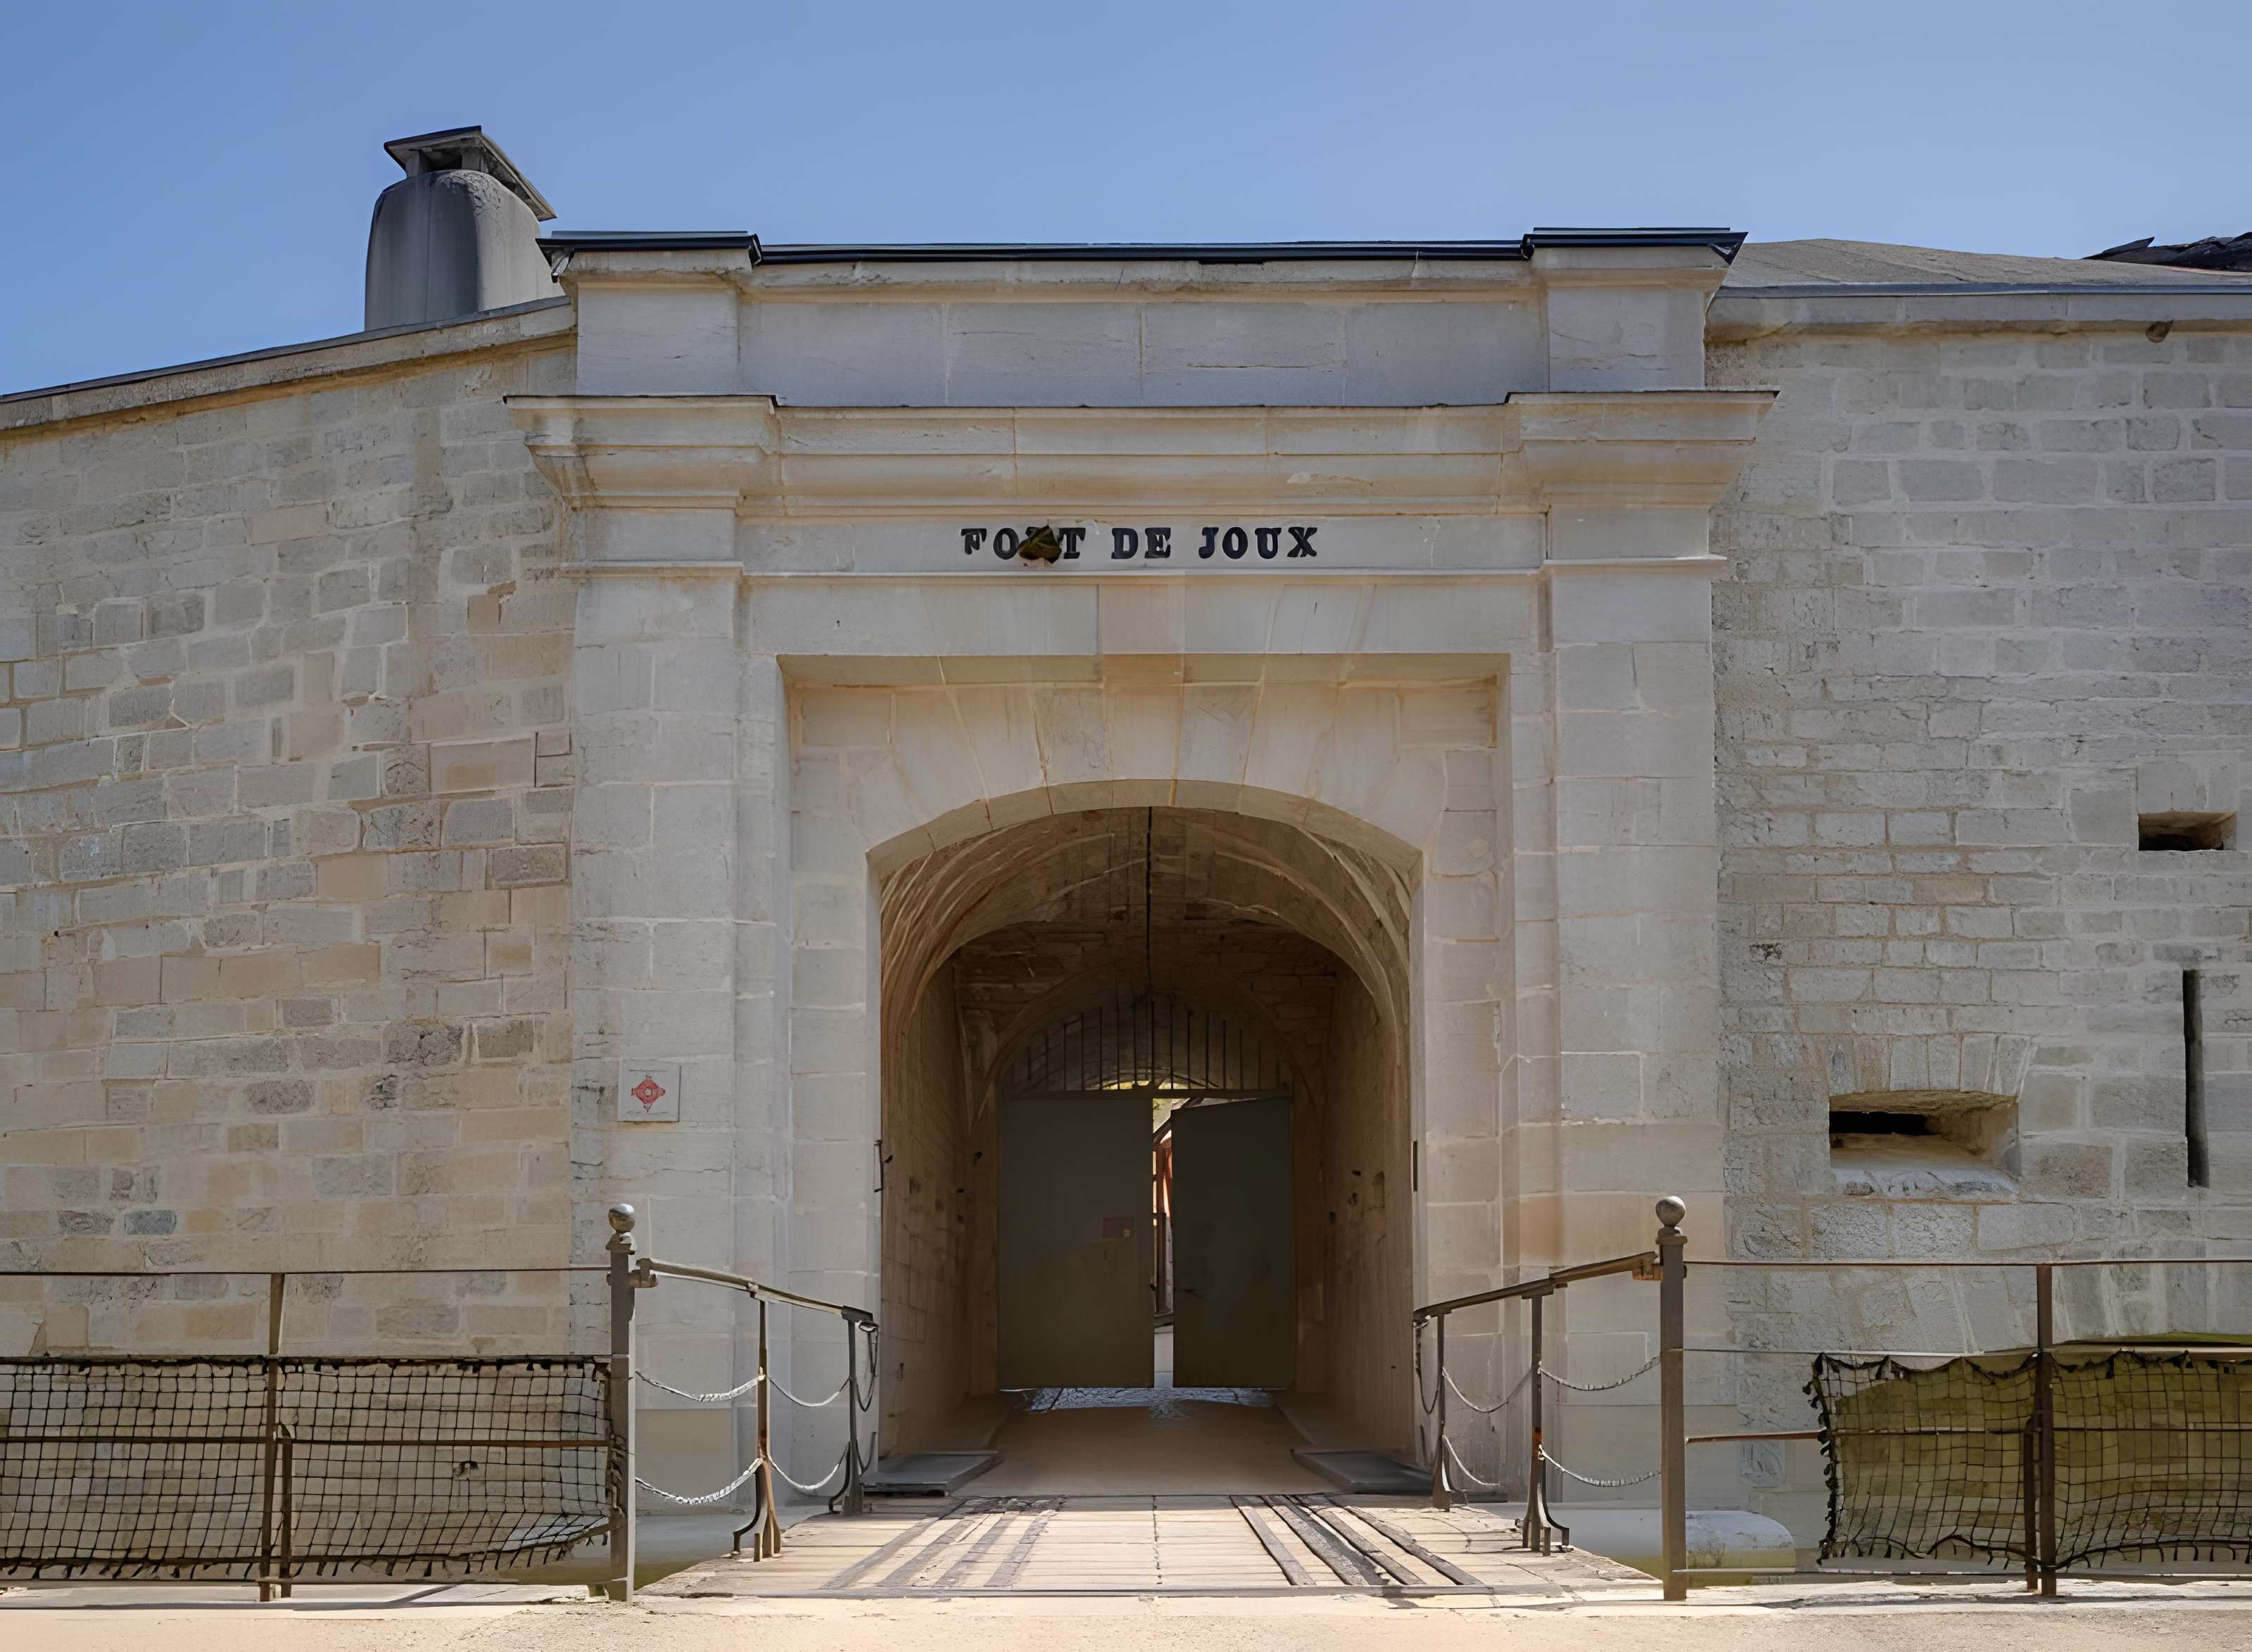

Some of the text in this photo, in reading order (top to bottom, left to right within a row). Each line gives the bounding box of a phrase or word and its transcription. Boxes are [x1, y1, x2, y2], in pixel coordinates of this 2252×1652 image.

[961, 526, 1318, 559] FOT DE JOUX
